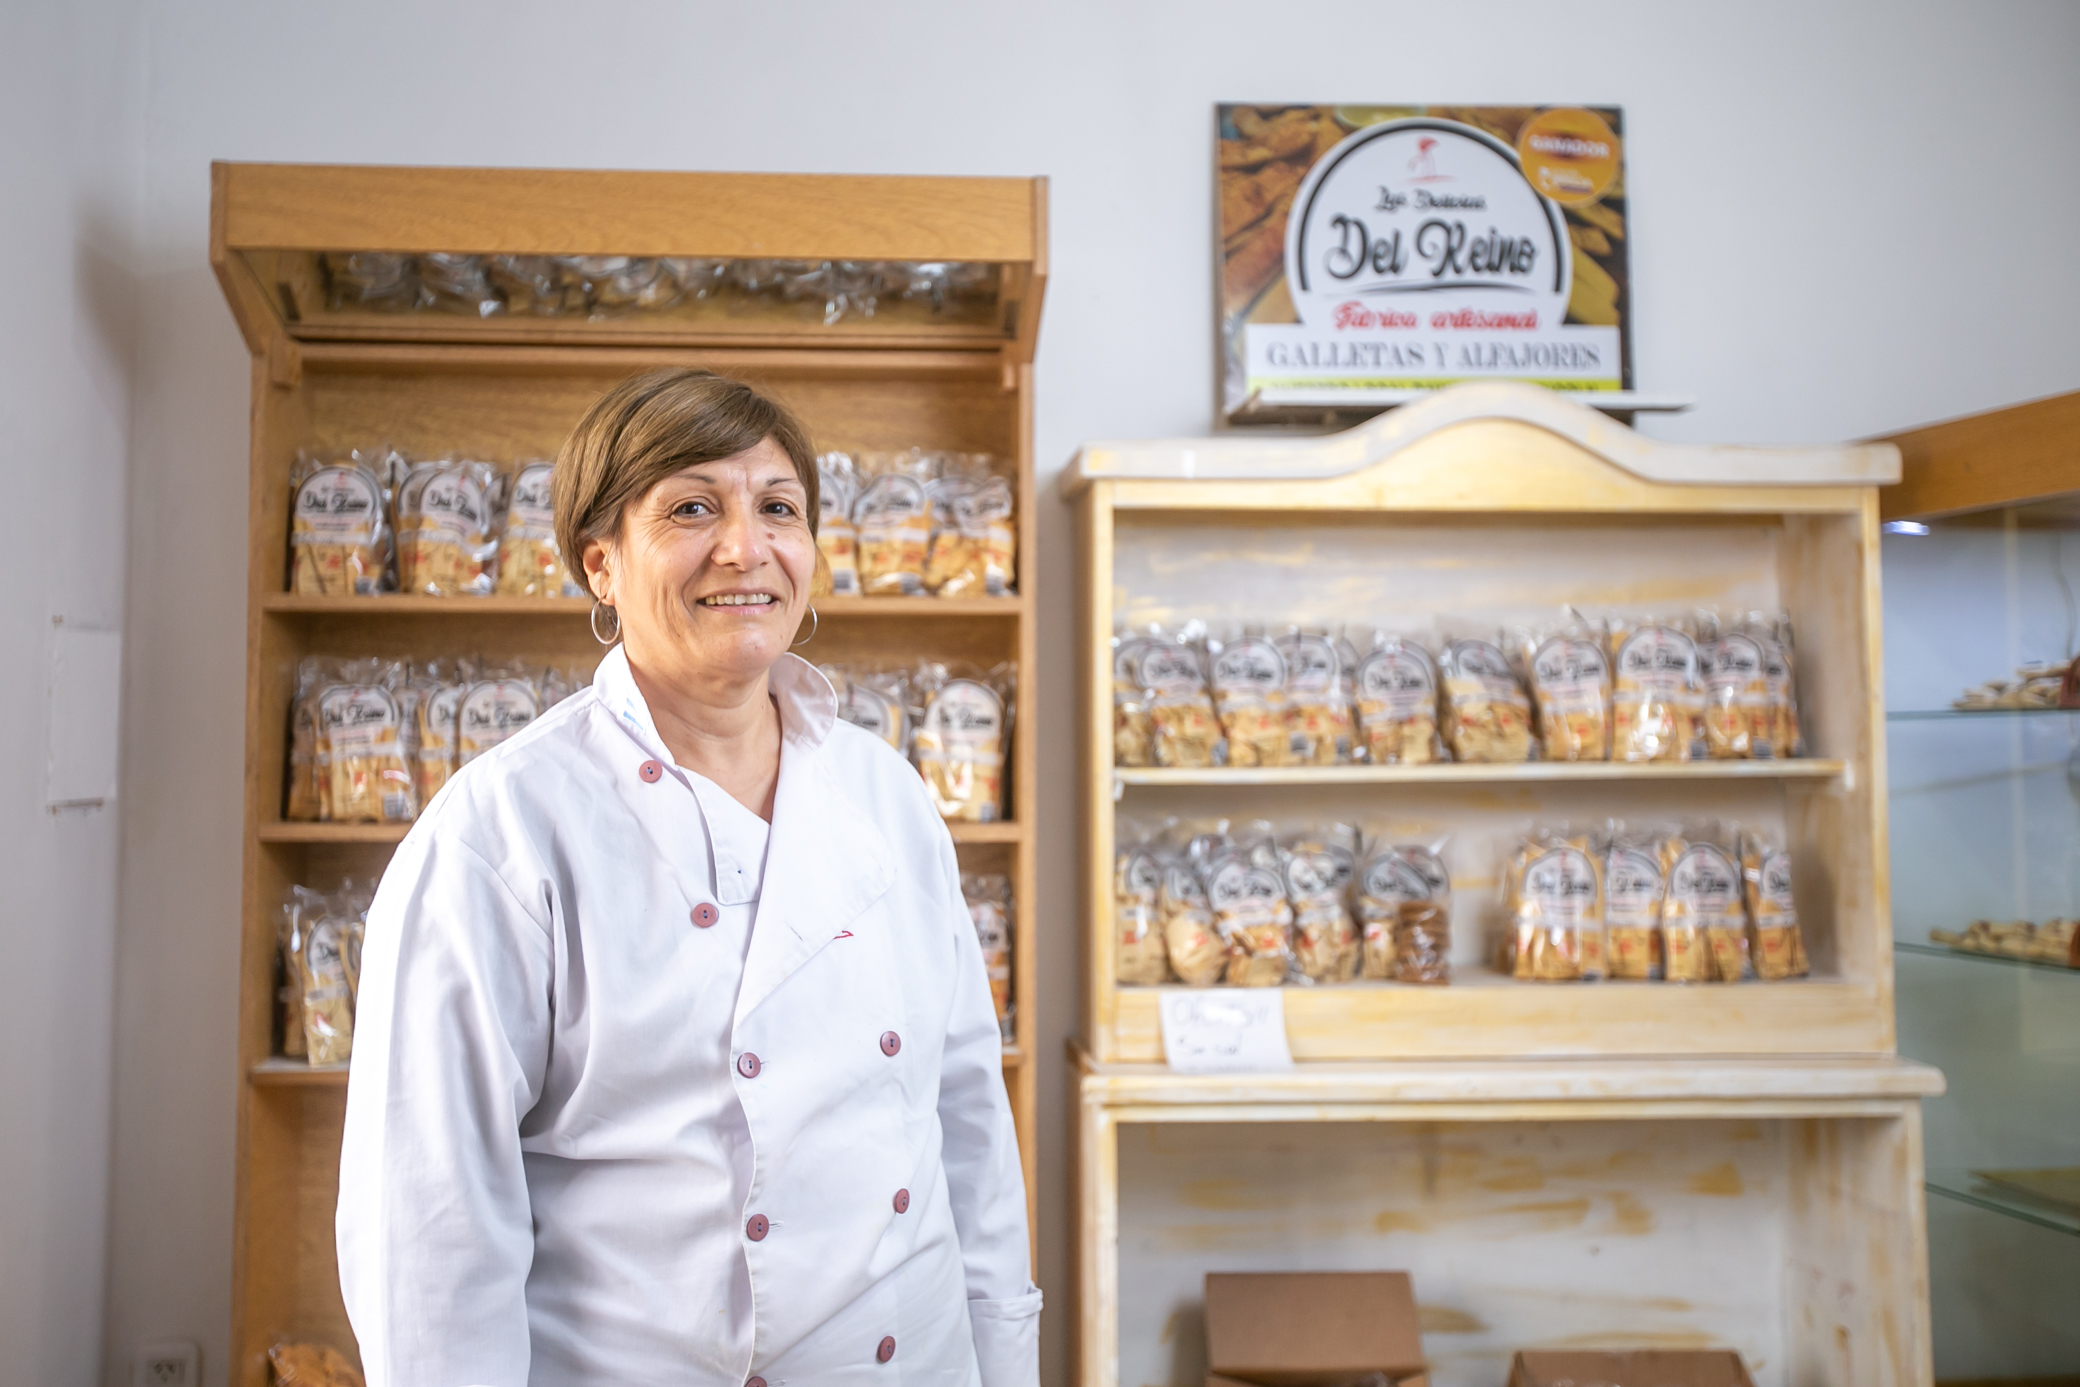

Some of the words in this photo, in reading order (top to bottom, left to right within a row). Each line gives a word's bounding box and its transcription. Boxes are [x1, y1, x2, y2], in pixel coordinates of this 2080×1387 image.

[1325, 214, 1406, 279] Del
[1417, 218, 1538, 278] Reino
[1431, 307, 1539, 330] artesanal
[1266, 341, 1425, 368] GALLETAS
[1432, 342, 1452, 369] Y
[1457, 342, 1601, 370] ALFAJORES
